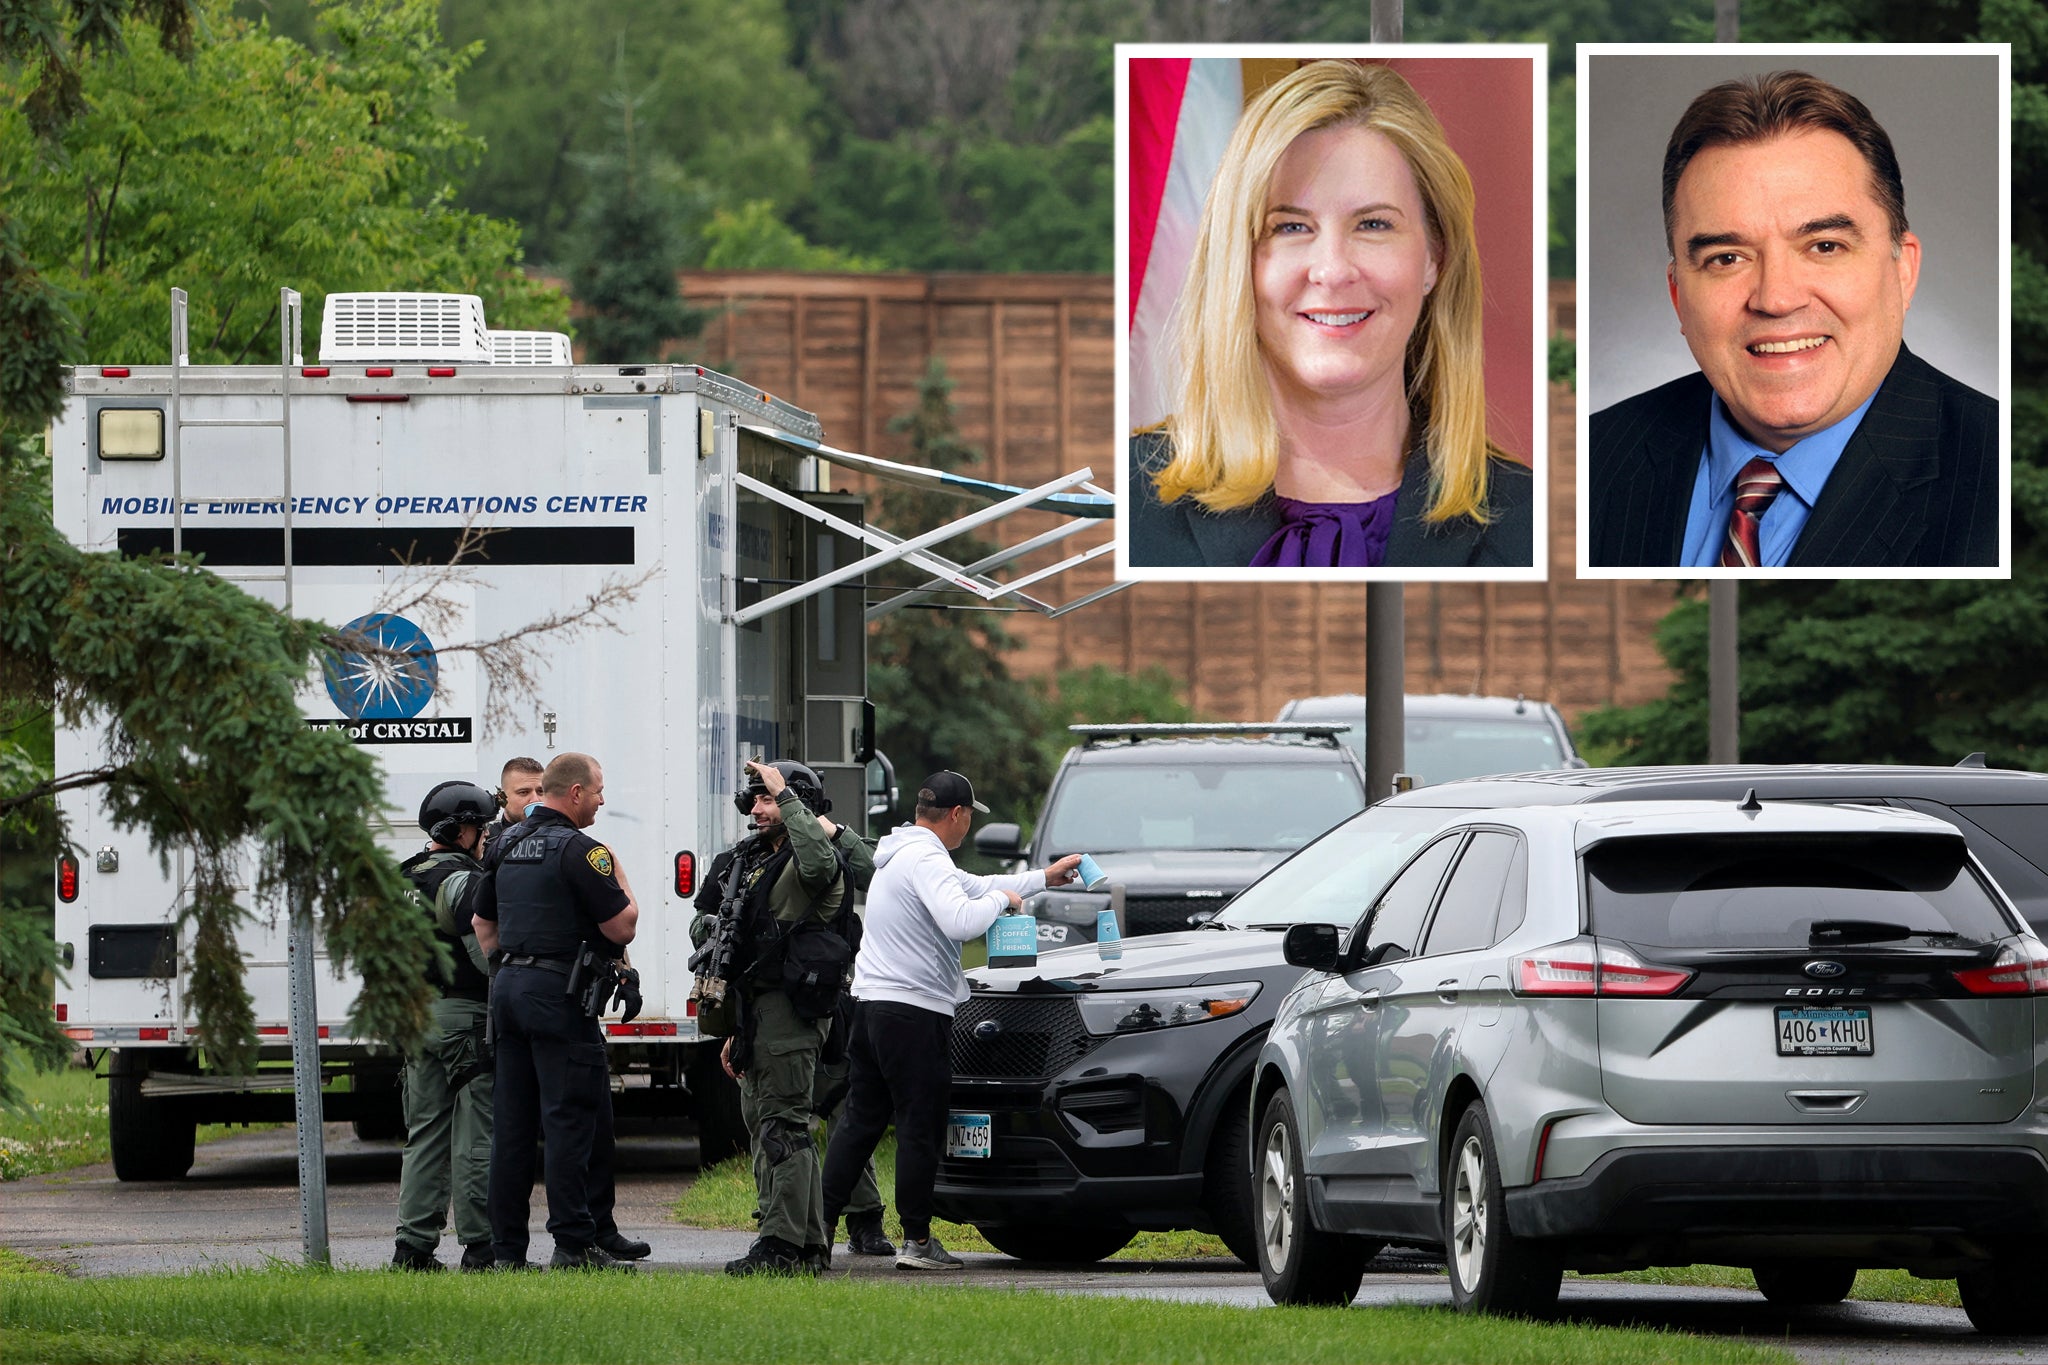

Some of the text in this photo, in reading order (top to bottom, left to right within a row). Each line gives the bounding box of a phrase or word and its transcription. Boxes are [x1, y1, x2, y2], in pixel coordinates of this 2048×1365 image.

[207, 497, 369, 514] EMERGENCY
[375, 496, 538, 514] OPERATIONS
[546, 495, 648, 513] CENTER
[349, 723, 369, 739] of
[373, 722, 465, 738] CRYSTAL
[506, 839, 544, 858] OLICE
[1035, 924, 1068, 942] 33
[1814, 963, 1837, 974] Ford
[1785, 988, 1865, 996] EDGE
[1801, 1010, 1845, 1018] Minnesota
[1783, 1020, 1866, 1043] 406 KHU
[950, 1125, 988, 1147] JNZ 659
